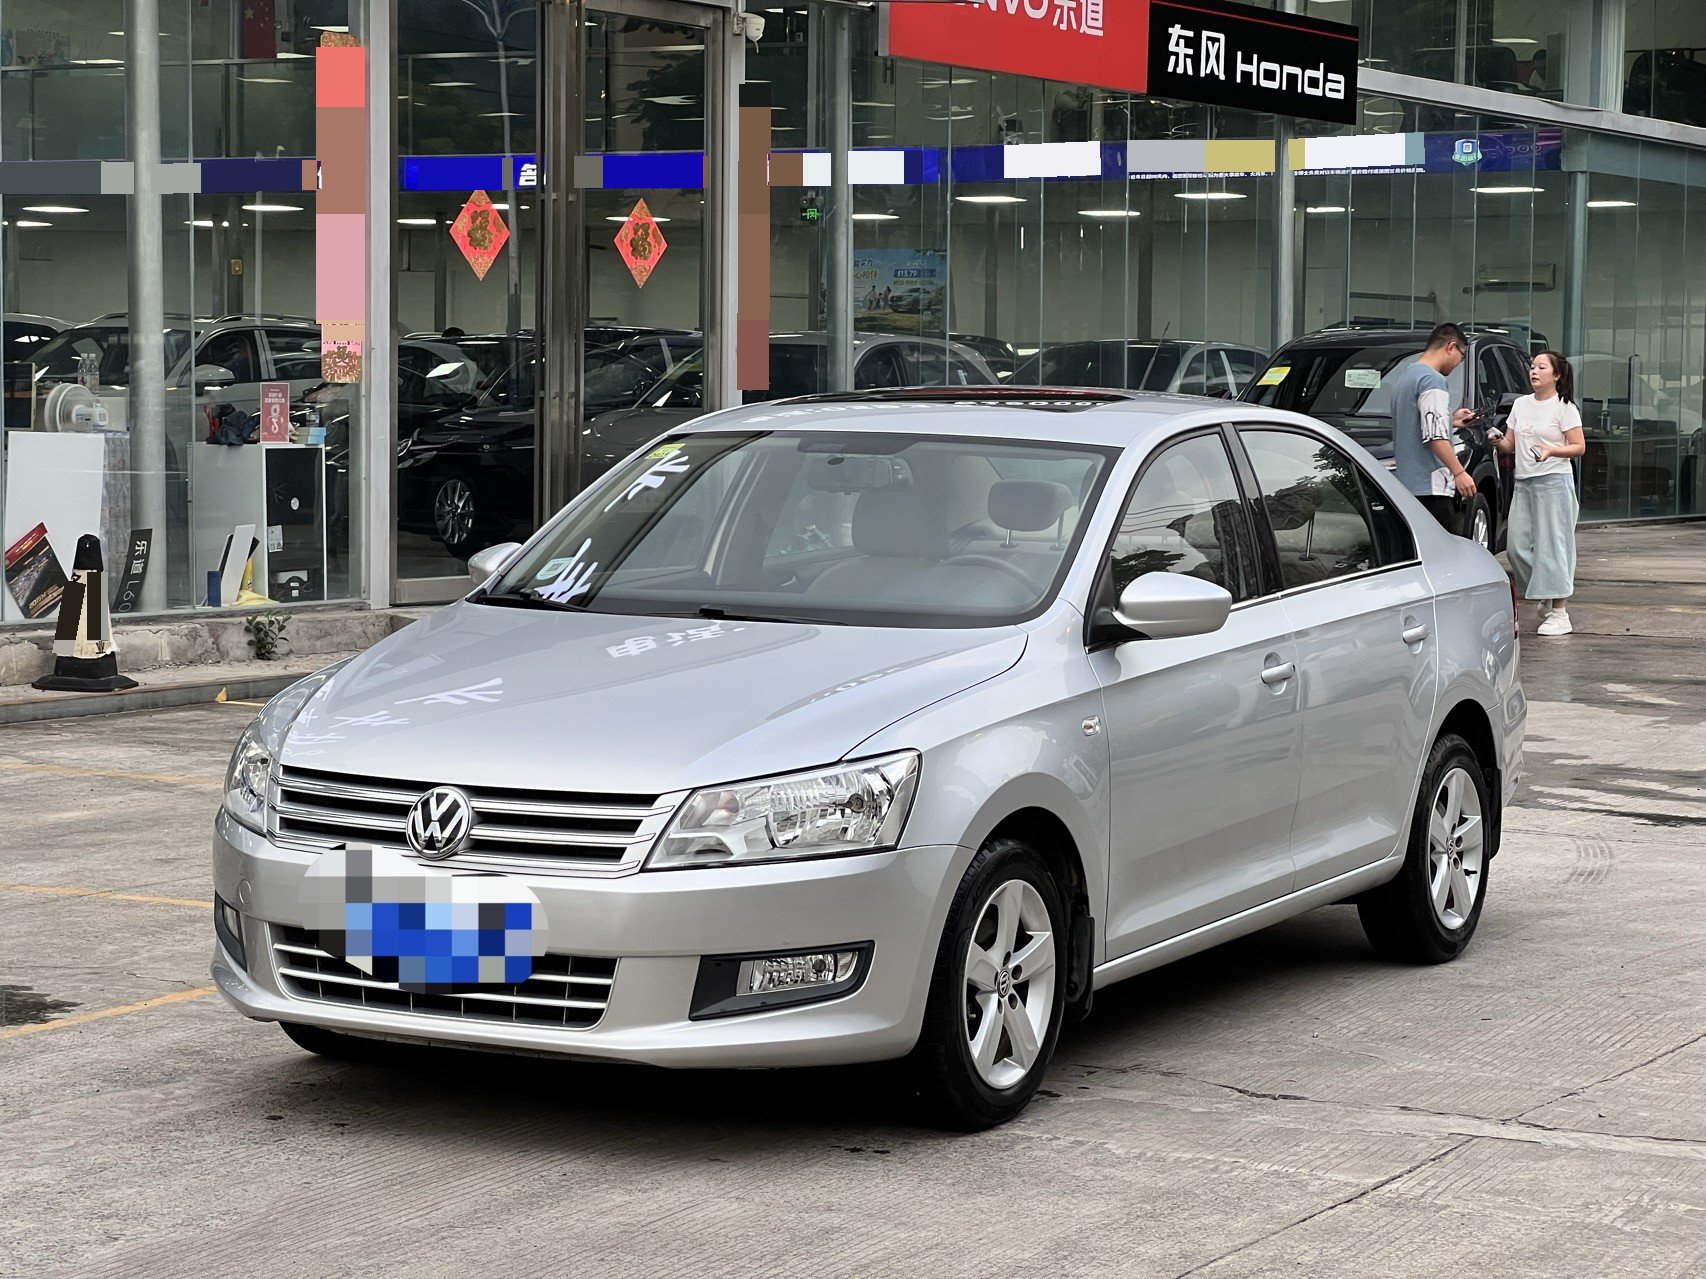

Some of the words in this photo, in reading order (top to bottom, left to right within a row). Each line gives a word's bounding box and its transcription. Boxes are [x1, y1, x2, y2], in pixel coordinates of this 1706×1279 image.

[1167, 23, 1226, 81] 东风
[1236, 50, 1345, 100] Honda
[130, 540, 148, 575] 乐道
[118, 580, 140, 613] L60
